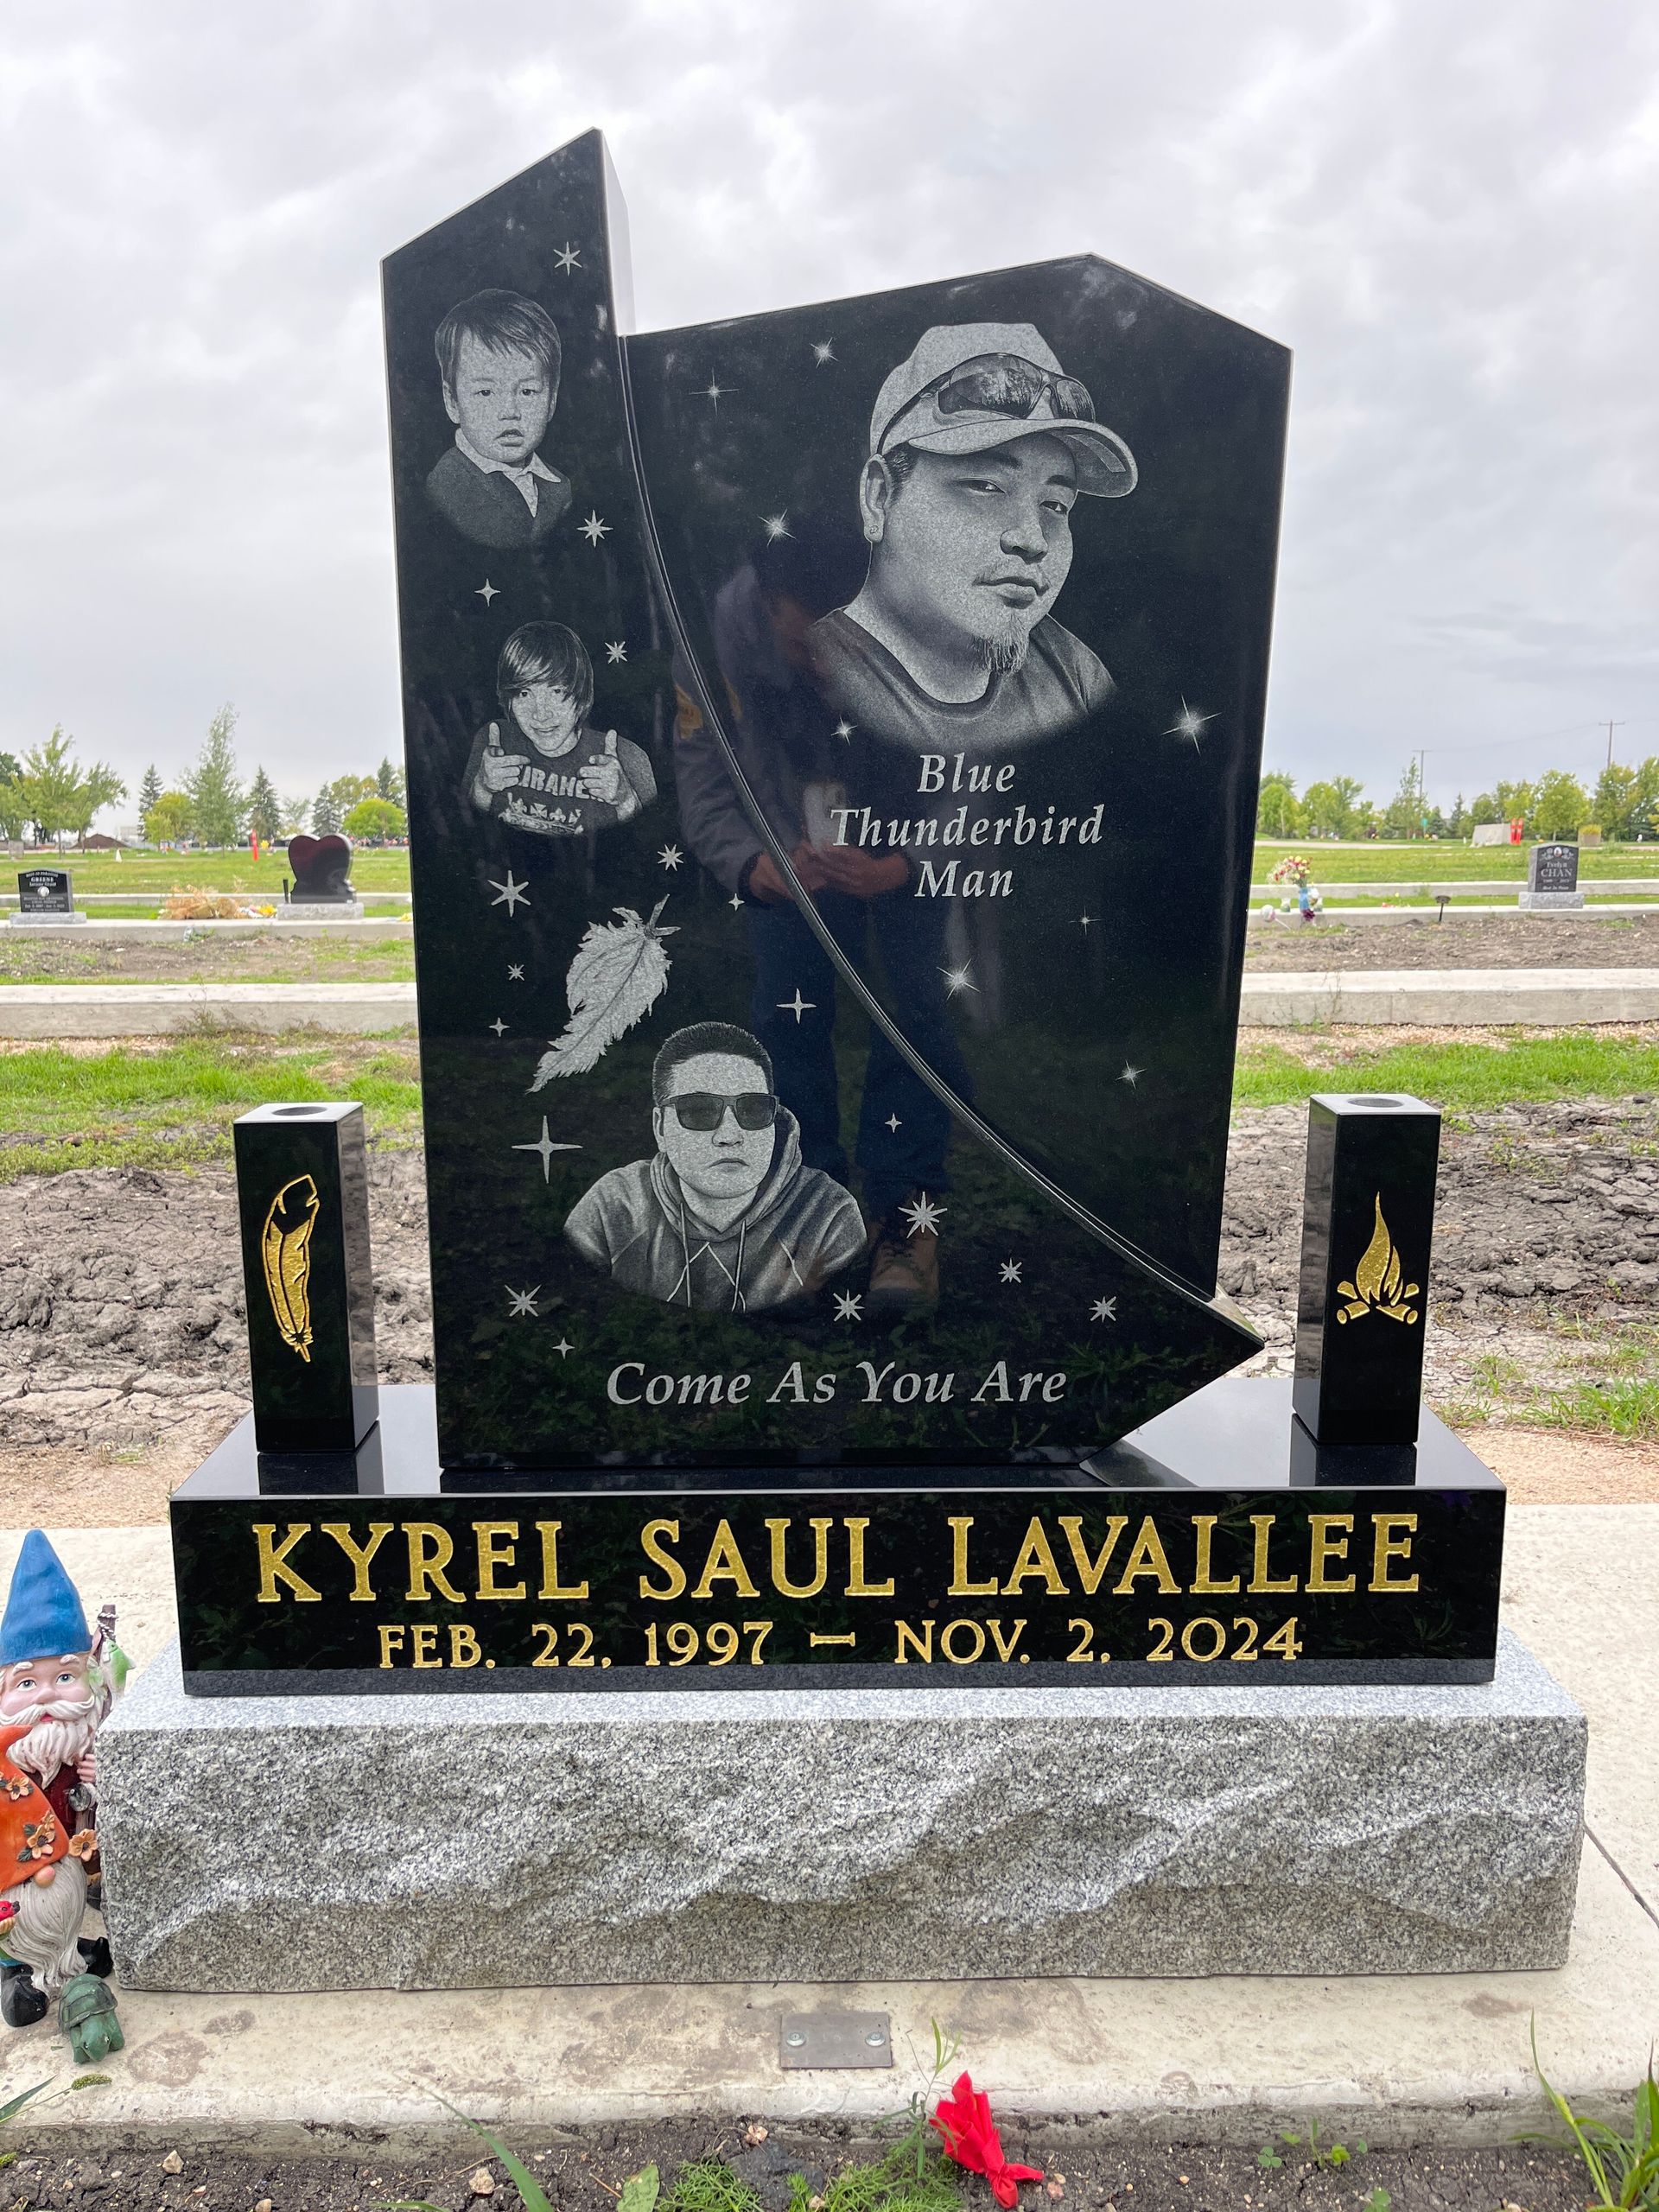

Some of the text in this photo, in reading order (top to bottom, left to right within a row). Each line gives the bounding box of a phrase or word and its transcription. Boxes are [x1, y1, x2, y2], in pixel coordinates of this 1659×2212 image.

[917, 752, 1016, 794] Blue
[830, 804, 1105, 847] Thunderbird
[913, 860, 1014, 898] Man
[1541, 868, 1573, 877] CHAN
[607, 1361, 1066, 1405] Come As You Are
[251, 1513, 1420, 1604] KYREL SAUL LAVALLEE
[377, 1624, 496, 1669] FEB.
[531, 1623, 612, 1669] 22,
[645, 1621, 772, 1667] 1997
[893, 1618, 1029, 1664] NOV.
[1147, 1617, 1303, 1662] 2024
